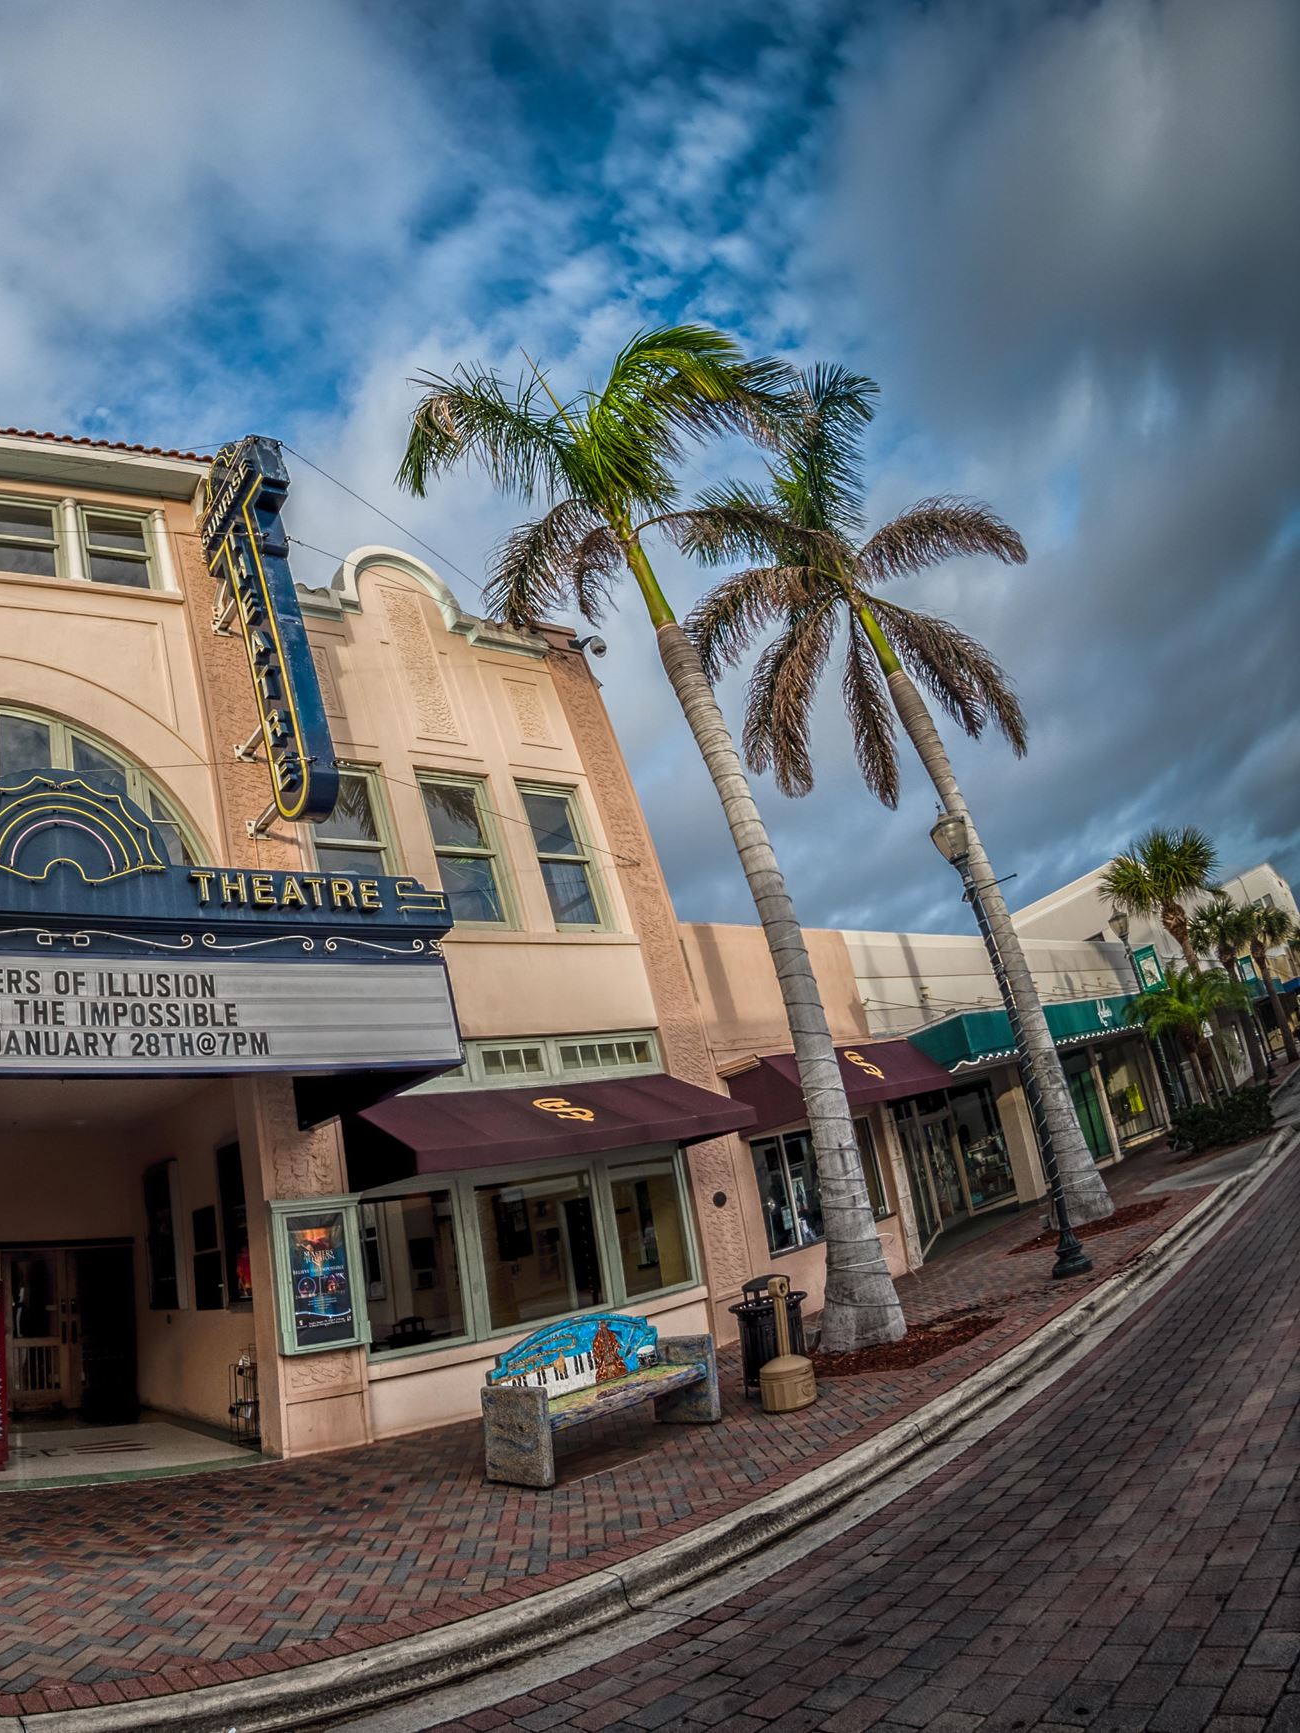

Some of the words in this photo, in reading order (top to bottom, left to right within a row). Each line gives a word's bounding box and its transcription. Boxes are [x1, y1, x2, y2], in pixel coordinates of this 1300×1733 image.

[201, 457, 256, 549] SUNRISE
[226, 520, 298, 794] THEATRE
[188, 869, 384, 911] THEATRE
[54, 971, 86, 995] OF
[98, 972, 216, 998] ILLUSION
[13, 1000, 65, 1025] THE
[79, 1001, 238, 1027] IMPOSSIBLE
[129, 1031, 270, 1056] 28TH@7PM
